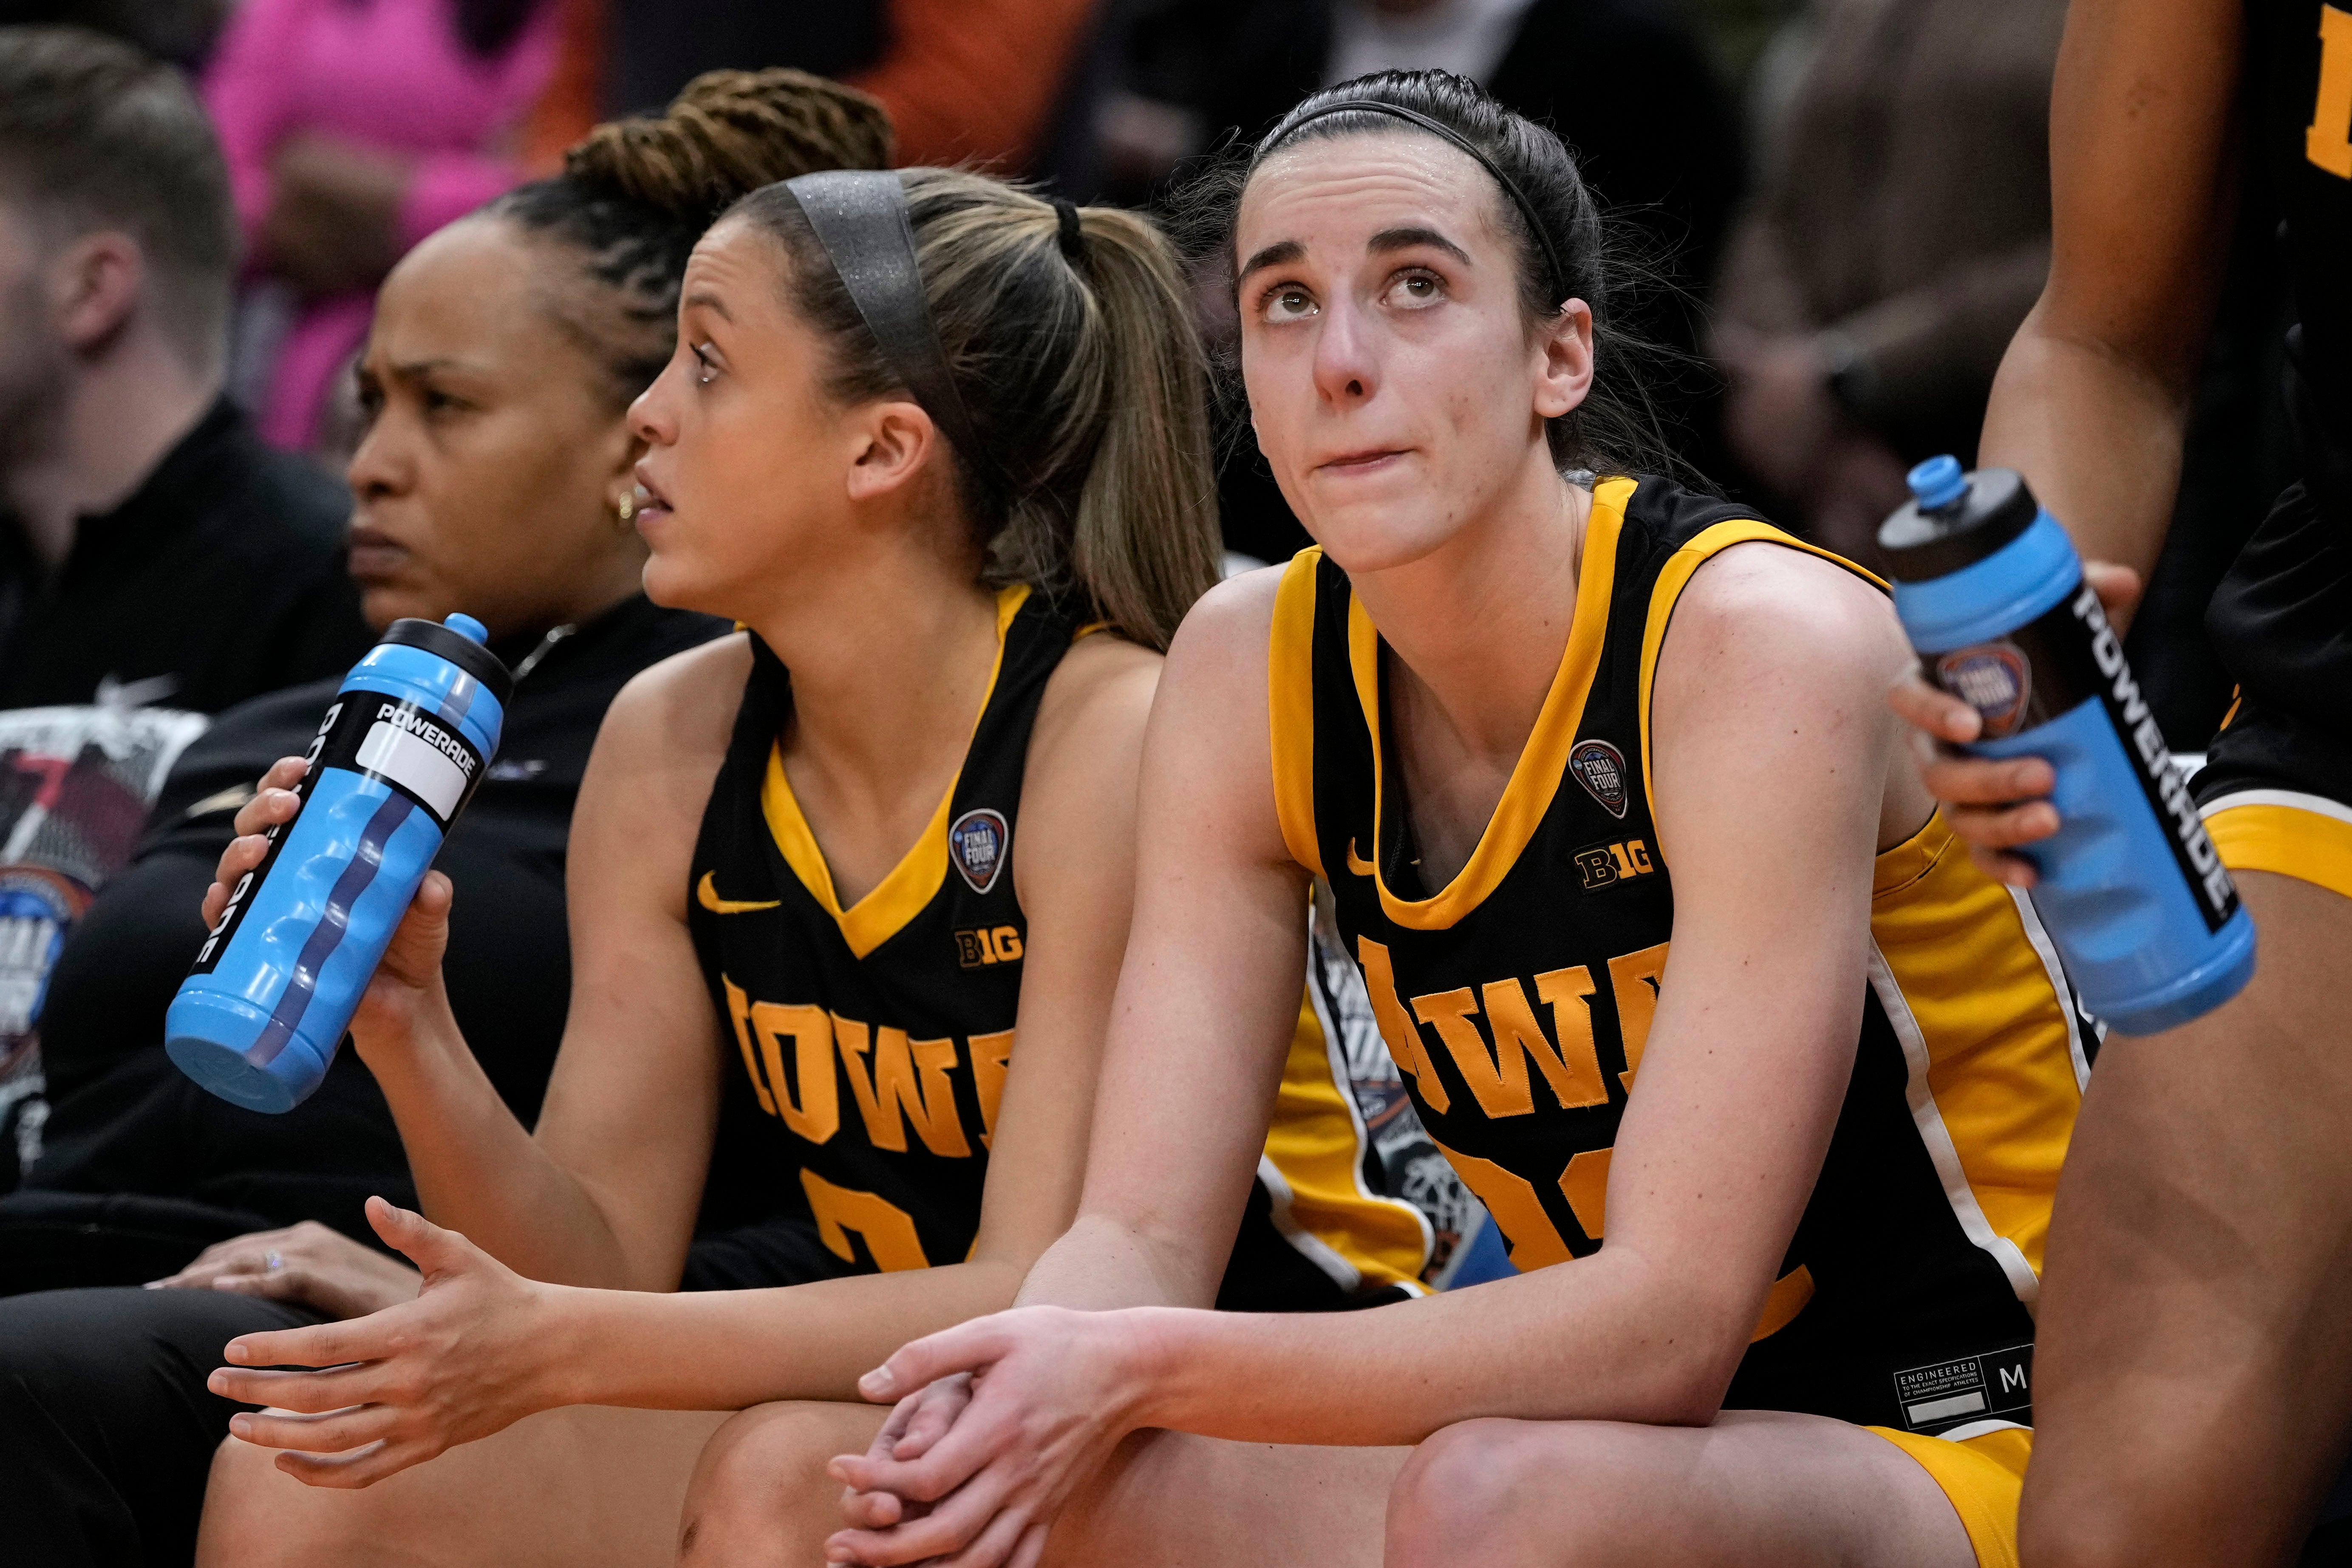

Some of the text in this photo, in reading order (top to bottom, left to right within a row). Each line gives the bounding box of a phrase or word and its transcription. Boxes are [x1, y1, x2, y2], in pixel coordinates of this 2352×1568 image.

[376, 703, 476, 778] POWERADE
[2073, 587, 2236, 914] POWERADE
[1583, 759, 1615, 775] FINAL
[1590, 773, 1621, 790] FOUR
[965, 844, 996, 866] FOUR
[1900, 1362, 1976, 1385] ENGINEERED
[1939, 1371, 1977, 1384] SPECIFICATIONS
[1999, 1364, 2027, 1393] M
[1913, 1384, 1951, 1395] CHAMPIONSHIP
[1953, 1377, 1979, 1387] ATHLETES
